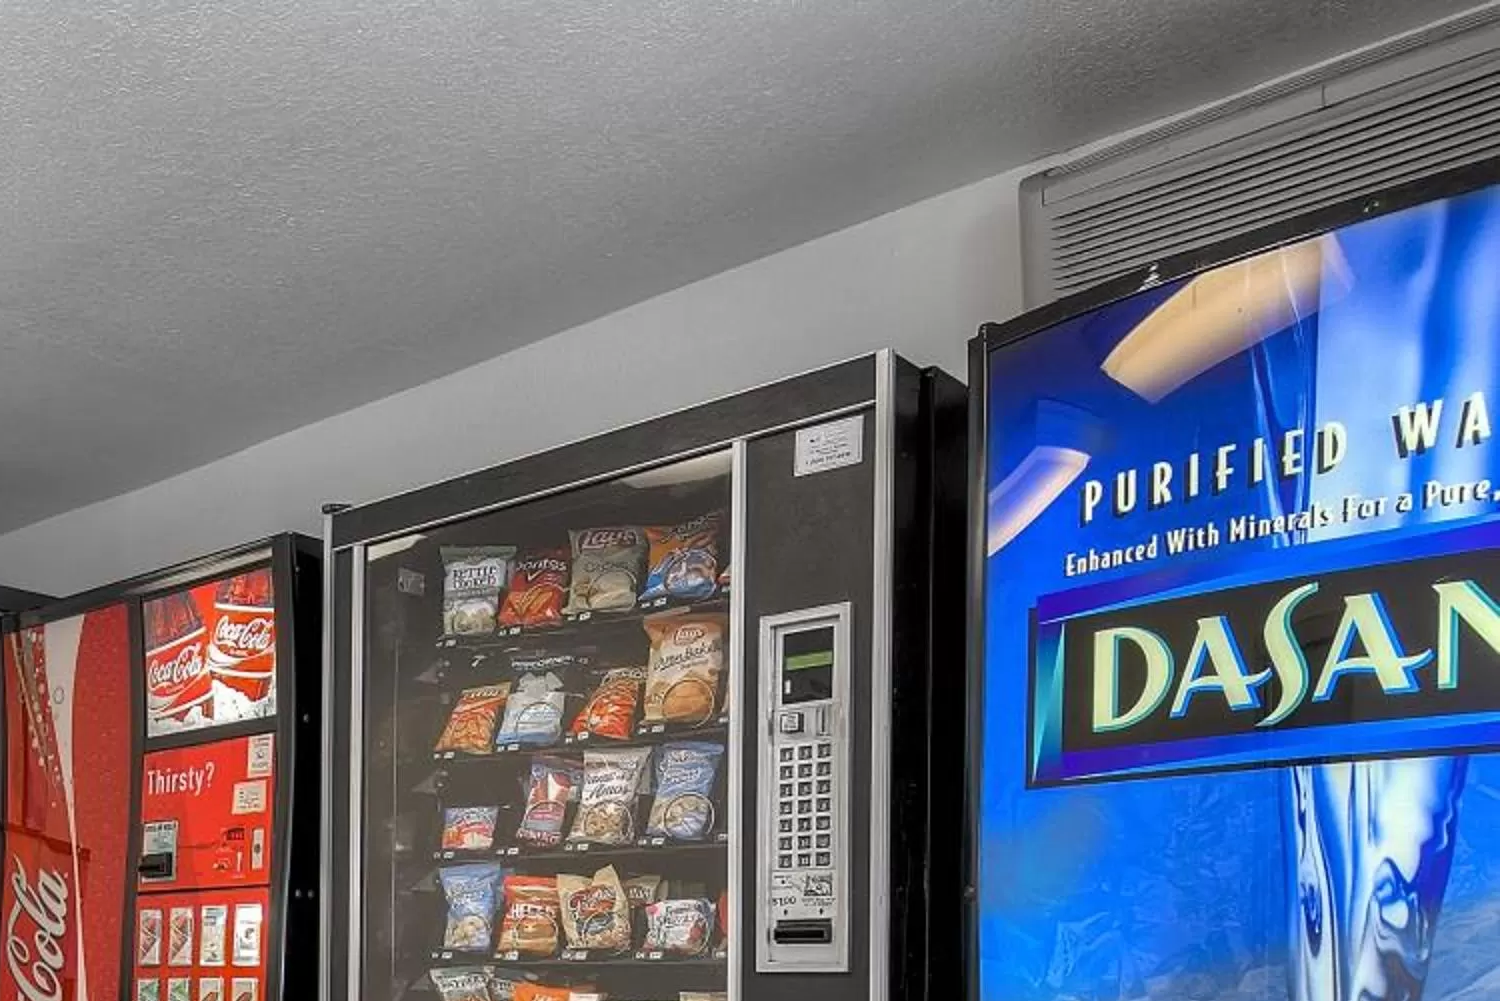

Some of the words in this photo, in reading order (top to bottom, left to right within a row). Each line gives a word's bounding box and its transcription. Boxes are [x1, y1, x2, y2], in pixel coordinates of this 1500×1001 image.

[1078, 420, 1349, 529] PURIFIED
[1064, 543, 1159, 578] Enhanced
[1164, 522, 1221, 557] With
[1229, 499, 1334, 544] Minerals
[1342, 493, 1389, 522] For
[1396, 493, 1413, 513] a
[213, 615, 274, 650] Coca-Cola
[149, 642, 203, 692] Coca-Cola
[147, 761, 215, 797] Thirsty?
